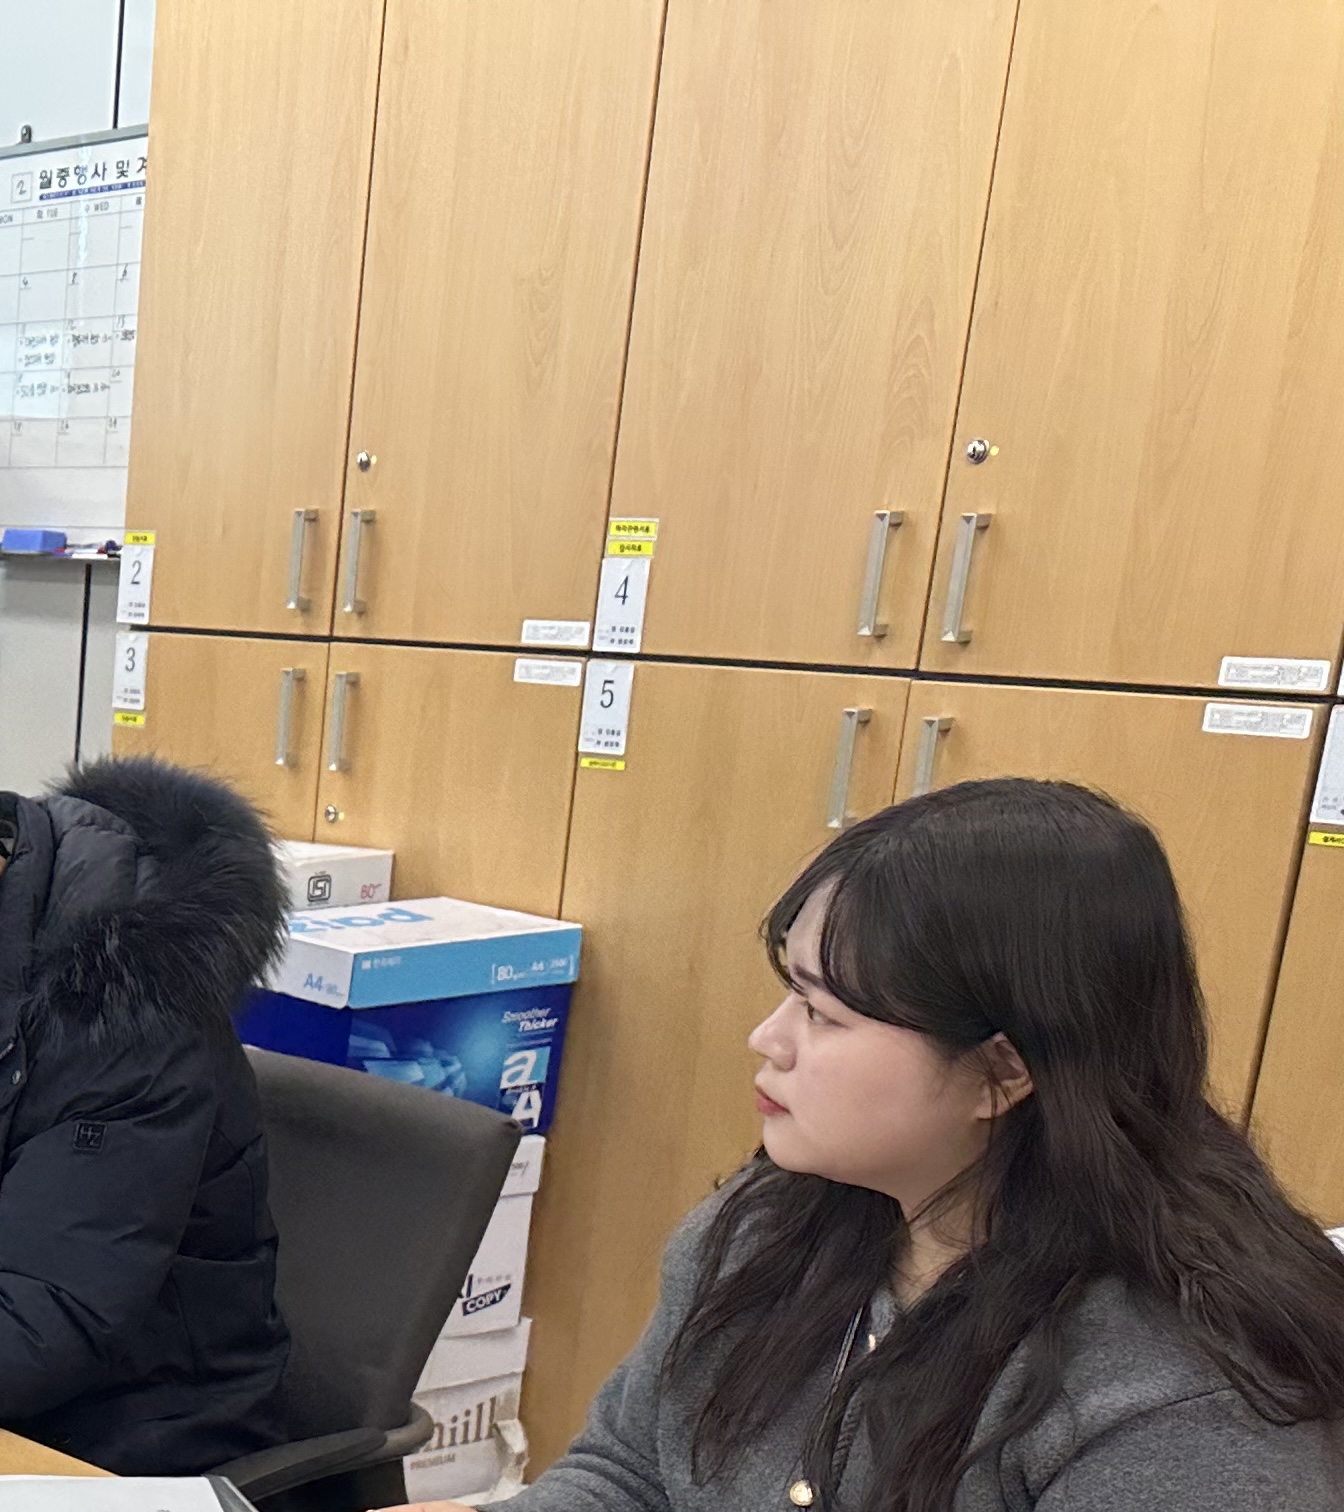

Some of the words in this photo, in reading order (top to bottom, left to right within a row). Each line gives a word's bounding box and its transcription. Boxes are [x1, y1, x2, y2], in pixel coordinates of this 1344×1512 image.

[115, 159, 130, 179] 및
[16, 180, 27, 196] 2
[131, 560, 142, 585] 2
[614, 575, 629, 605] 4
[125, 647, 136, 672] 3
[600, 680, 614, 708] 5
[303, 973, 324, 993] A4
[519, 1018, 558, 1032] Thicker
[465, 1289, 503, 1312] COPY
